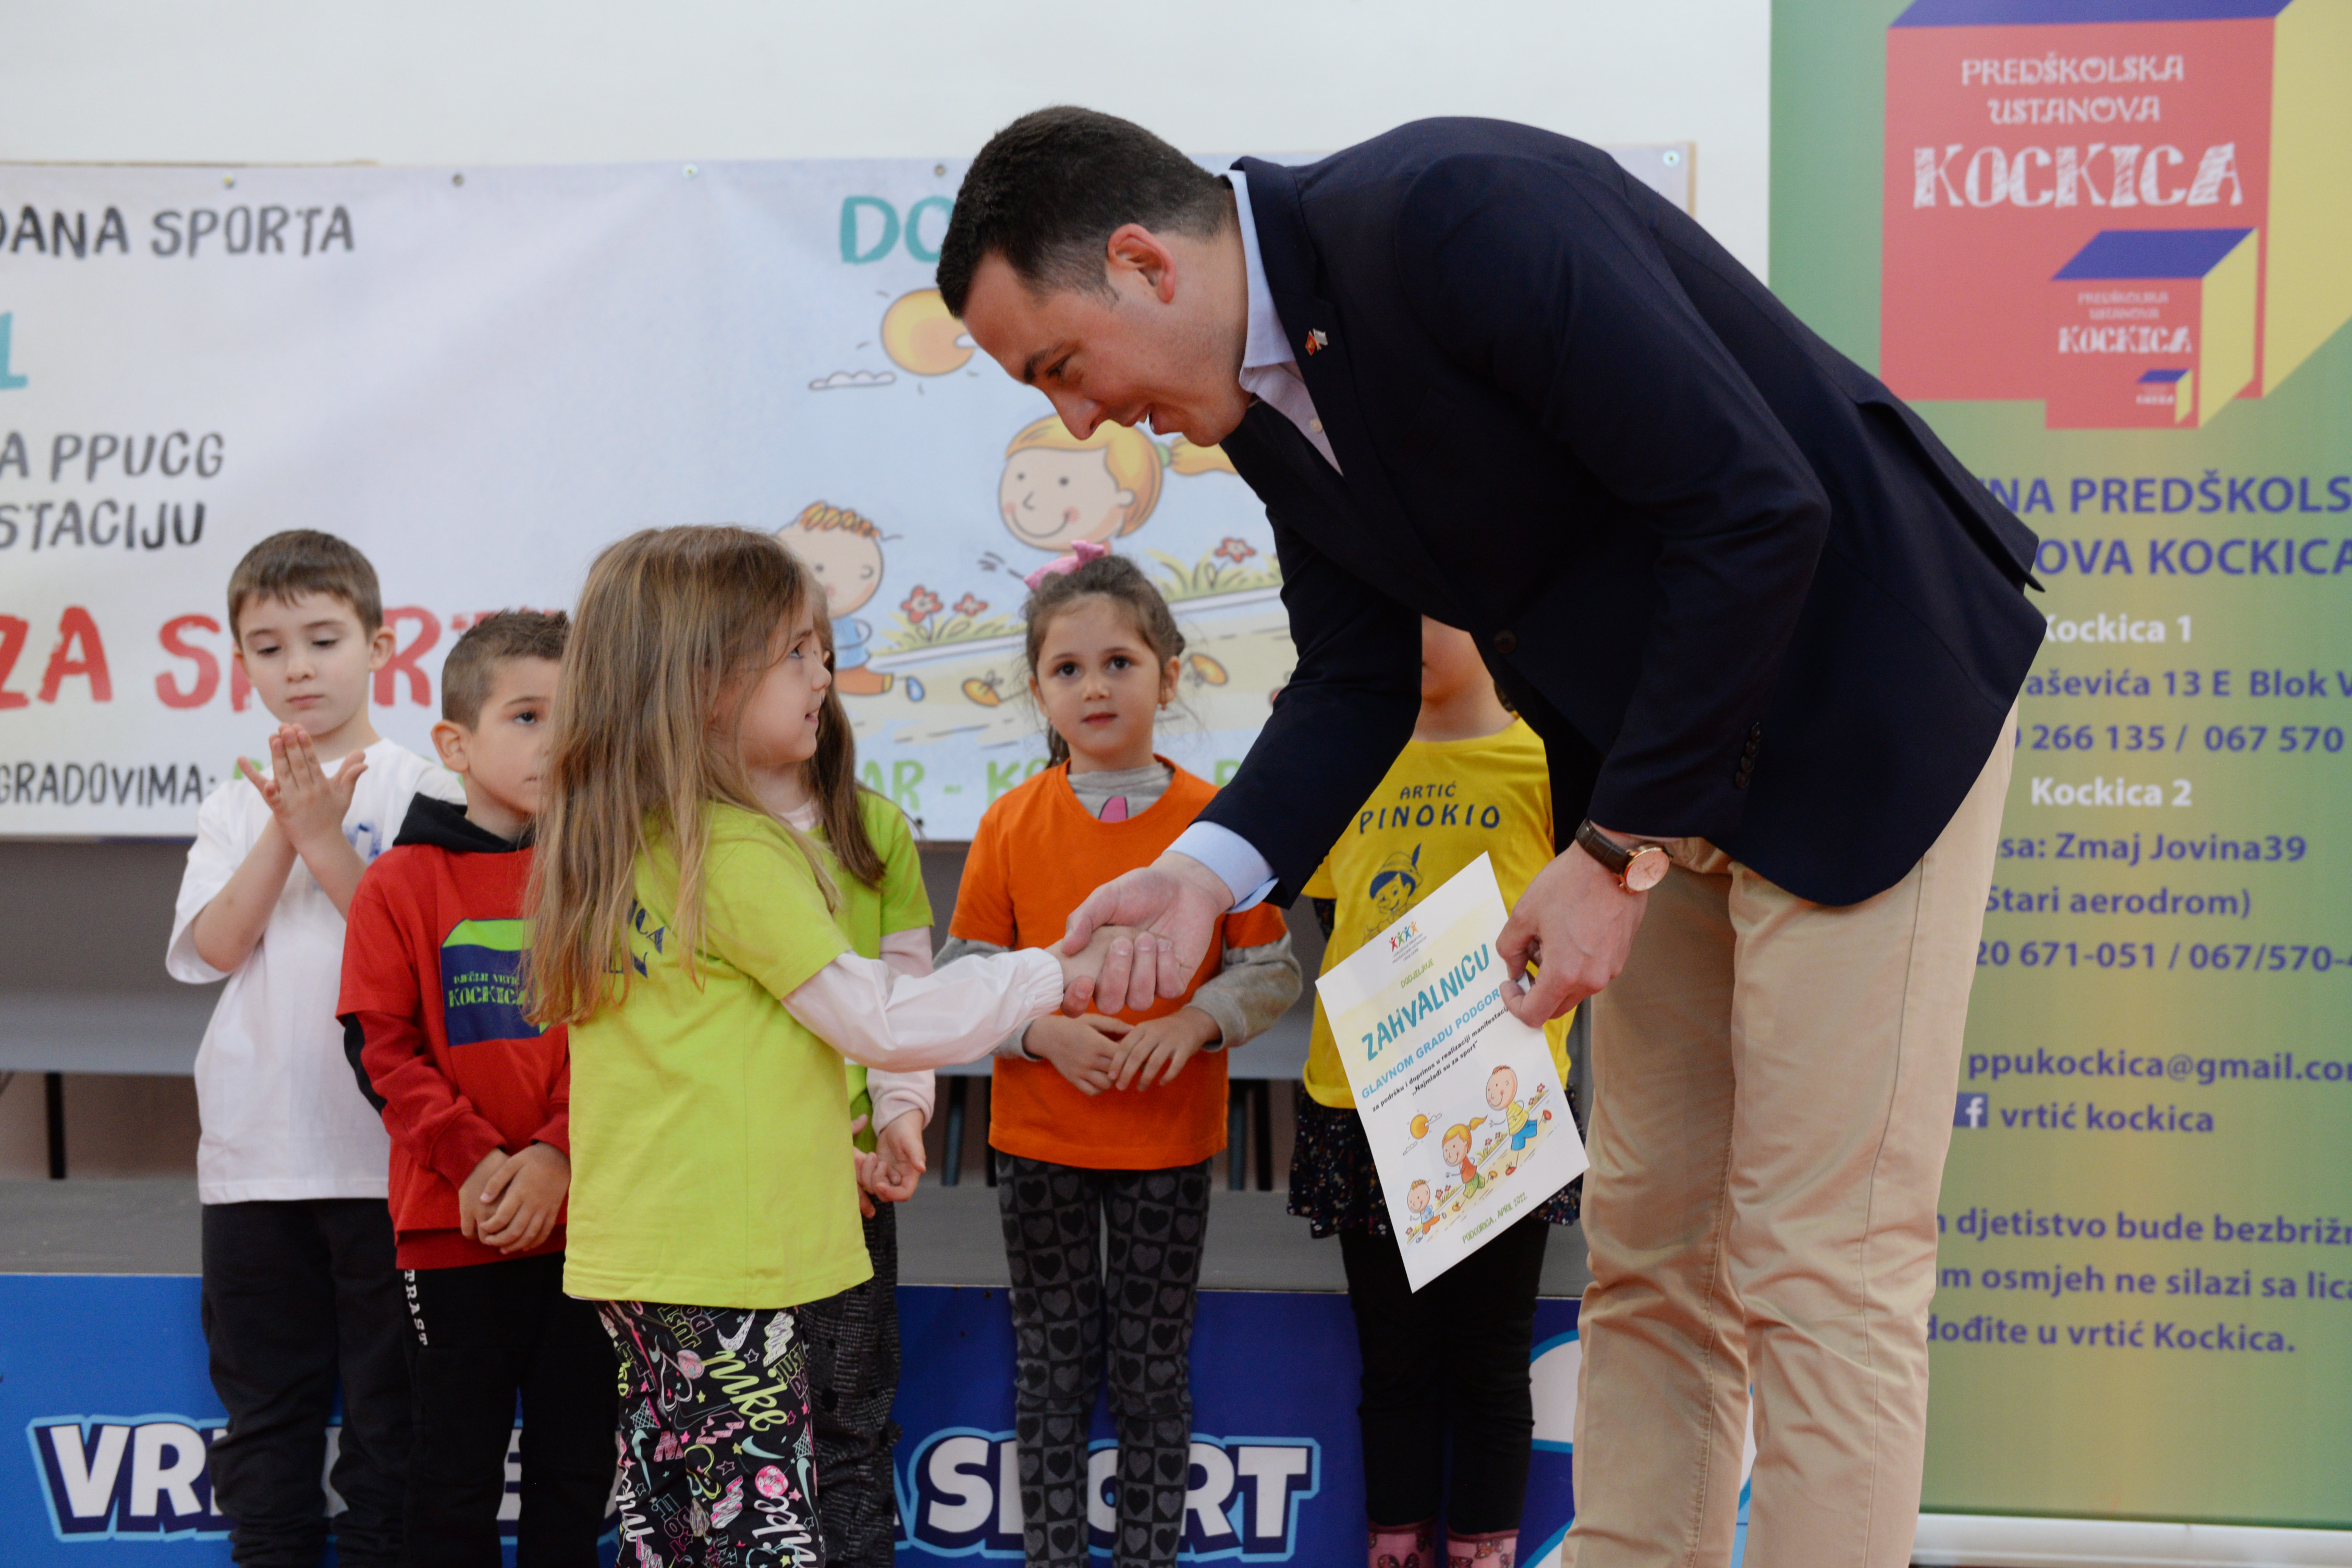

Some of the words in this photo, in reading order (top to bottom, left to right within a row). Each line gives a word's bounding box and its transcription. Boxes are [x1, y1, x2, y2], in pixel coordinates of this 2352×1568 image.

[1962, 52, 2184, 86] PREDŠKOLSKA
[1987, 96, 2160, 125] USTANOVA
[1913, 142, 2243, 209] KOCKICA
[0, 205, 130, 259] ANA
[151, 205, 355, 258] SPORTA
[2059, 325, 2192, 353] KOCKICA
[51, 431, 224, 482] PPUCG
[1979, 478, 2055, 513] NA
[2071, 469, 2351, 514] PREDŠKOLS
[2035, 539, 2133, 575] OVA
[2177, 615, 2191, 643] 1
[2026, 669, 2151, 697] aševića
[2164, 671, 2201, 697] 13
[2213, 671, 2232, 697] E
[2250, 668, 2328, 697] Blok
[2031, 725, 2093, 751] 266
[2106, 725, 2166, 751] 135
[2204, 725, 2268, 752] 067
[2279, 726, 2344, 754] 570
[2031, 777, 2164, 807] Kockica
[2172, 779, 2192, 806] 2
[1359, 804, 1500, 835] PINOKIO
[1998, 837, 2046, 859] sa:
[2054, 833, 2141, 867] Zmaj
[2150, 833, 2307, 863] Jovina39
[2069, 888, 2251, 919] aerodrom)
[2019, 941, 2155, 969] 671-051
[2189, 942, 2352, 973] 067/570-
[1362, 944, 1489, 1061] ZAHVALNICU
[1362, 1055, 1414, 1098] GLAVNOM
[1416, 1025, 1453, 1058] GRADU
[1455, 988, 1501, 1029] PODGOR
[1381, 1086, 1404, 1107] podršku
[1409, 1063, 1435, 1085] doprinos
[1441, 1033, 1471, 1061] realizaciji
[2000, 1100, 2077, 1129] vrtić
[2087, 1104, 2214, 1133] kockica
[1498, 1203, 1513, 1218] APRIL
[1956, 1207, 2107, 1242] djetistvo
[2117, 1211, 2204, 1241] bude
[1981, 1264, 2105, 1298] osmjeh
[2116, 1271, 2156, 1294] ne
[2166, 1267, 2251, 1296] silazi
[2261, 1275, 2296, 1298] sa
[2039, 1326, 2057, 1345] u
[2067, 1320, 2145, 1347] vrtić
[2154, 1322, 2295, 1352] Kockica.
